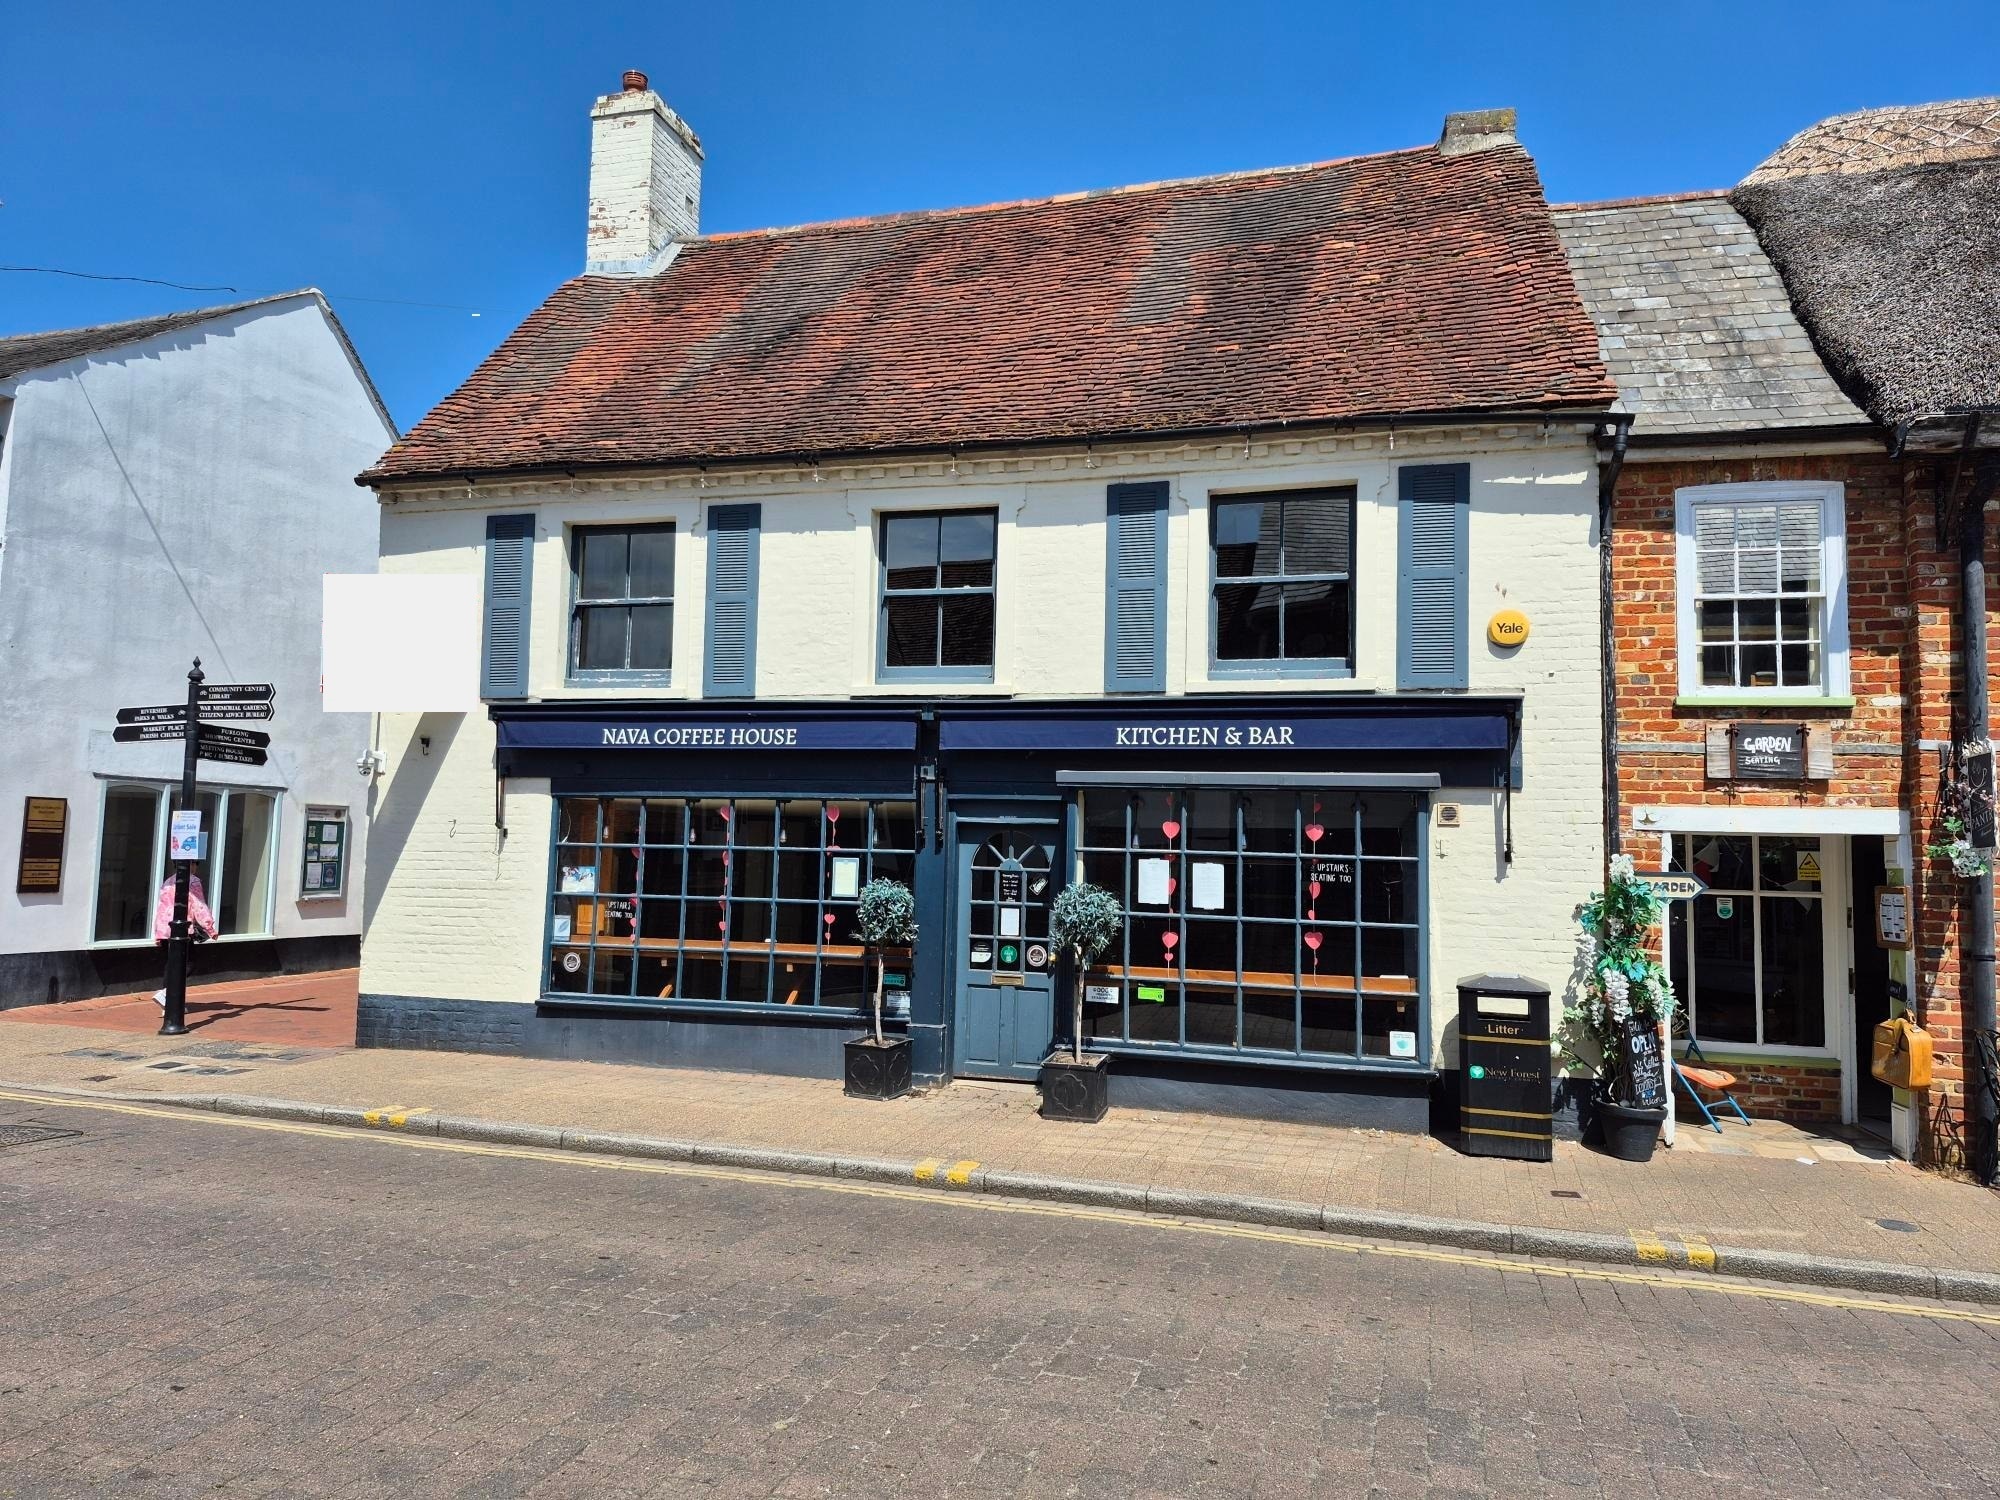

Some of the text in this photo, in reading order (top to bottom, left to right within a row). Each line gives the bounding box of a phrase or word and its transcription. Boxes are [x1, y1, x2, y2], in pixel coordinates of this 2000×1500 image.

[1496, 622, 1523, 633] Yale
[221, 728, 249, 738] FURLONG
[602, 728, 797, 745] NAVA COFFEE HOUSE
[1116, 726, 1295, 745] KITCHEN & BAR
[204, 733, 256, 745] SHOPPING CENTRE
[1743, 735, 1792, 754] GARDEN
[200, 744, 224, 753] MEETING
[1745, 756, 1780, 765] SEATING
[1317, 863, 1349, 873] UPSTAIRS
[1310, 872, 1352, 883] SEATING TOO
[1652, 881, 1696, 892] ARDEN
[607, 901, 631, 910] UPSTAIRS
[1488, 1024, 1520, 1034] Litter
[1631, 1031, 1656, 1054] OPEN
[1485, 1067, 1507, 1076] New
[1511, 1068, 1540, 1079] Forest
